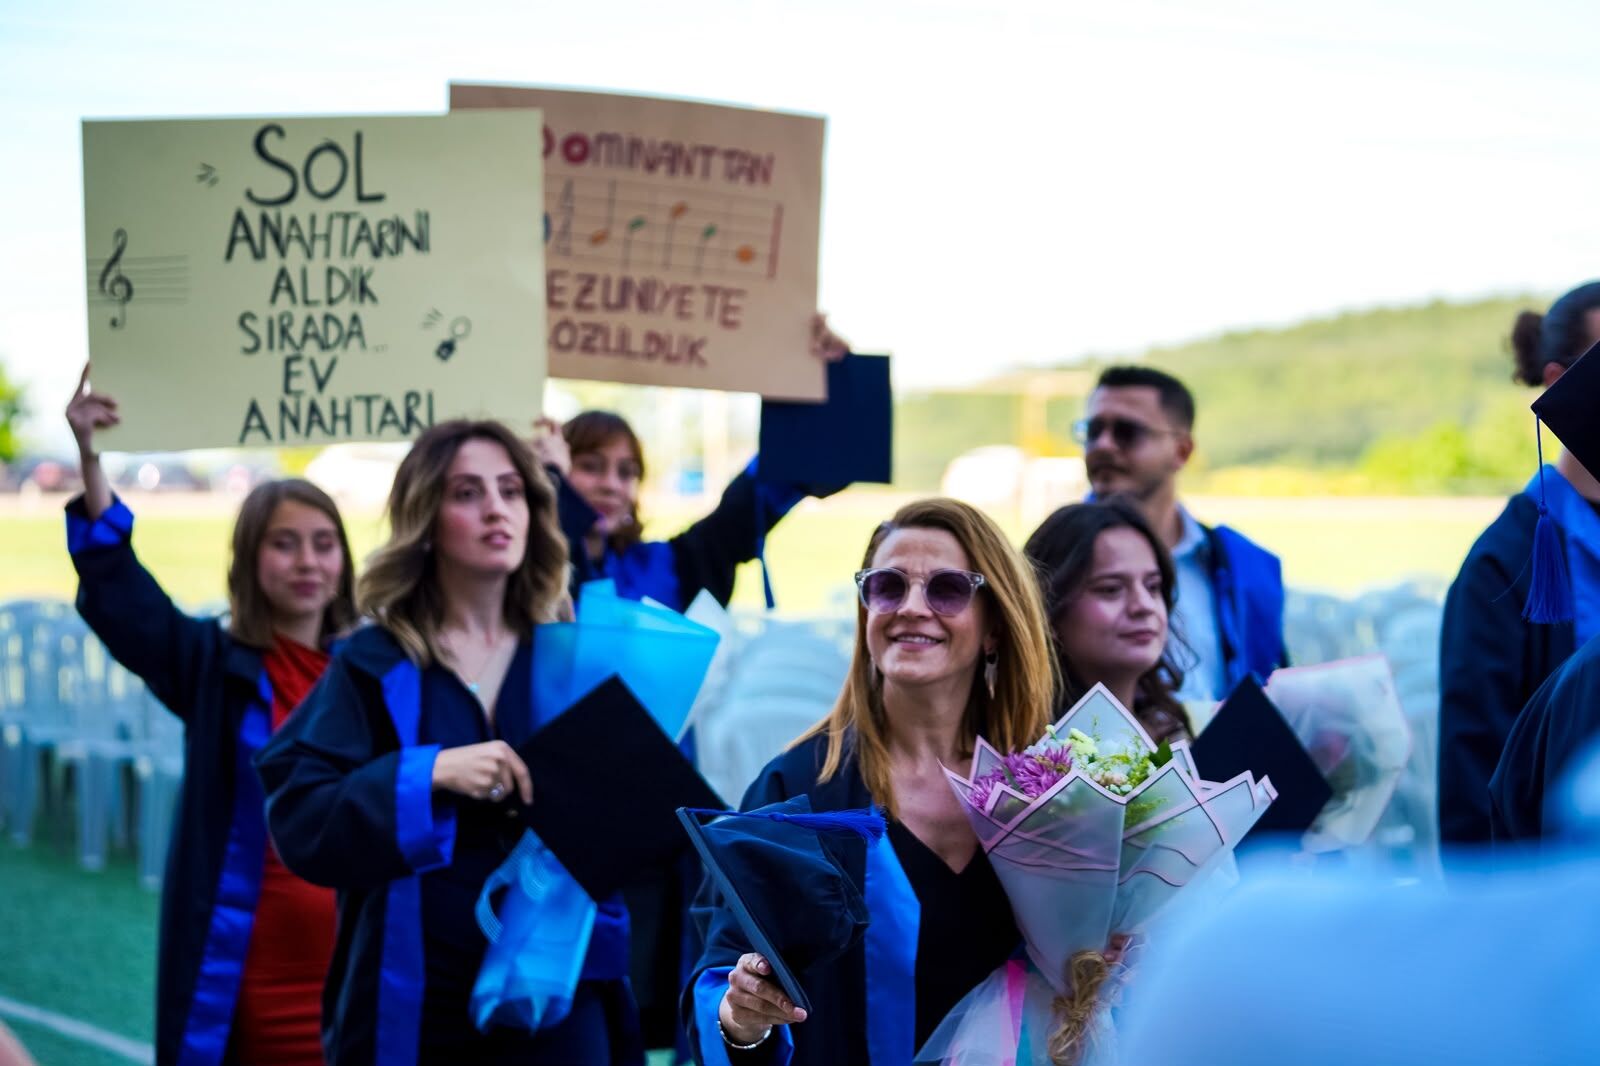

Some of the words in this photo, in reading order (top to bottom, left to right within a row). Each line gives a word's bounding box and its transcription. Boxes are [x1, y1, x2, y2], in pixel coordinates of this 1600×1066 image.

[245, 123, 386, 207] SOL
[225, 207, 431, 262] ANAHTARINI
[269, 264, 379, 307] ALDIK
[546, 269, 748, 331] EZUNIYETE
[283, 354, 338, 396] EV
[238, 390, 435, 445] ANAHTARI
